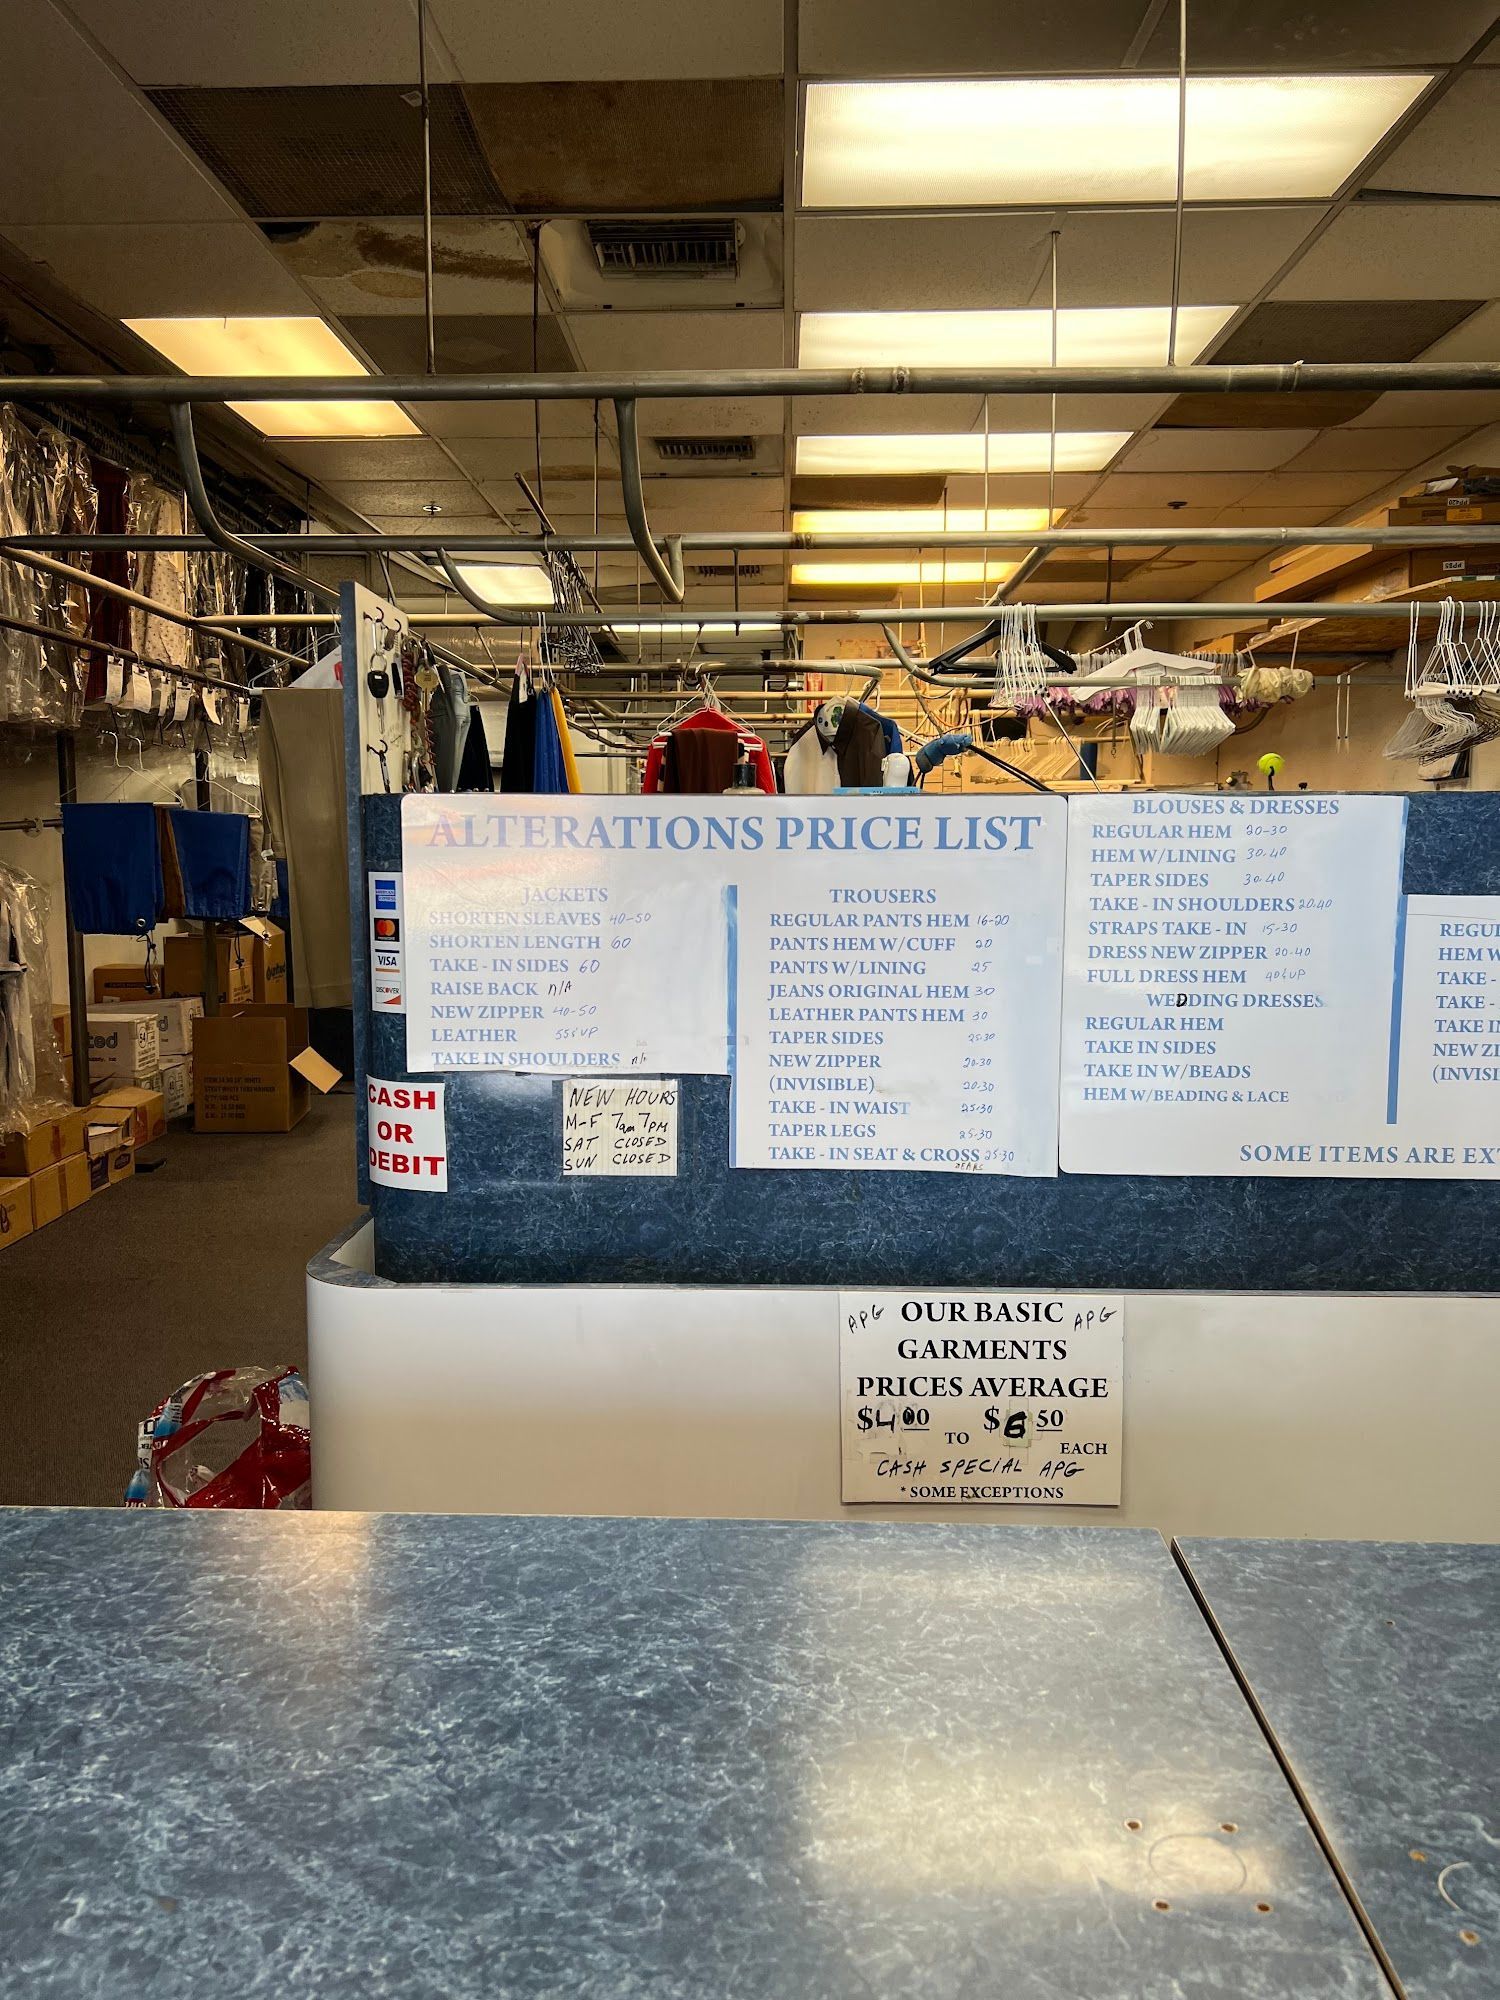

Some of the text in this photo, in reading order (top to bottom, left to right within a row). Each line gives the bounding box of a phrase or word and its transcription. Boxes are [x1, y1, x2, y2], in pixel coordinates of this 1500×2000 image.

[1132, 800, 1339, 814] BLOUSES & DRESSES
[426, 814, 1041, 851] ALTERATIONS PRICE LIST
[1093, 825, 1288, 838] REGULAR HEM 20-30
[1092, 849, 1135, 862] HEM
[1139, 848, 1236, 864] W/LINING
[1090, 873, 1152, 886] TAPER
[1155, 873, 1208, 887] SIDES
[521, 887, 608, 905] JACKETS
[829, 889, 936, 903] TROUSERS
[1090, 898, 1138, 910] TAKE
[1153, 898, 1174, 911] IN
[1178, 898, 1294, 911] SHOULDERS
[430, 912, 518, 926] SHORTEN
[523, 912, 601, 926] SLEAVES
[770, 914, 859, 927] REGULAR
[863, 914, 922, 927] PANTS
[927, 914, 969, 927] HEM
[1089, 922, 1157, 935] STRAPS
[1162, 922, 1211, 935] TAKE
[1226, 922, 1246, 935] IN
[430, 935, 631, 949] SHORTEN LENGTH 60
[770, 937, 828, 950] PANTS
[833, 938, 875, 950] HEM
[879, 937, 955, 952] W/CUFF
[1088, 946, 1147, 959] DRESS
[1151, 946, 1196, 959] NEW
[1200, 946, 1268, 959] ZIPPER
[1439, 948, 1483, 961] HEM
[378, 956, 397, 966] VISA
[430, 959, 600, 973] TAKE IN SIDES 60
[770, 961, 828, 974] PANTS
[832, 960, 925, 976] W/LINING
[1088, 970, 1135, 982] FULL
[1139, 970, 1198, 983] DRESS
[1203, 970, 1246, 983] HEM
[1437, 972, 1486, 985] TAKE
[376, 986, 400, 994] DISCOVER
[431, 982, 483, 995] RAISE
[488, 982, 539, 995] BACK
[767, 985, 995, 1001] JEANS ORIGINAL HEM 30
[1146, 993, 1325, 1009] WEDDING DRESSES
[1436, 996, 1485, 1009] TAKE
[431, 1006, 474, 1018] NEW
[478, 1006, 544, 1019] ZIPPER
[769, 1008, 988, 1022] LEATHER PANTS HEM 30
[1086, 1017, 1224, 1030] REGULAR HEM
[1435, 1020, 1483, 1033] TAKE
[432, 1029, 517, 1042] LEATHER
[769, 1031, 828, 1044] TAPER
[832, 1031, 883, 1044] SIDES
[1085, 1041, 1216, 1054] TAKE IN SIDES
[1433, 1044, 1478, 1056] NEW
[432, 1052, 647, 1068] TAKE IN SHOULDERS n/
[769, 1055, 812, 1067] NEW
[816, 1055, 881, 1068] ZIPPER
[1084, 1064, 1250, 1079] TAKE IN W/BEADS
[770, 1075, 875, 1094] (INVISIBLE)
[368, 1084, 436, 1110] CASH
[570, 1085, 678, 1108] NEW HOURS
[1084, 1088, 1289, 1102] HEM W/BEADING & LACE
[769, 1101, 816, 1113] TAKE
[830, 1101, 850, 1114] IN
[853, 1100, 911, 1115] WAIST
[566, 1112, 602, 1130] M-F
[378, 1121, 414, 1144] OR
[769, 1124, 827, 1136] TAPER
[832, 1125, 875, 1137] LEGS
[564, 1136, 667, 1152] SAT CLOSED
[370, 1146, 444, 1176] DEBIT
[564, 1153, 671, 1170] SUN CLOSED
[768, 1147, 815, 1159] TAKE
[830, 1148, 849, 1160] IN
[854, 1148, 898, 1160] SEAT
[903, 1148, 915, 1161] &
[921, 1148, 979, 1162] CROSS
[1240, 1145, 1500, 1164] SOME ITEMS ARE EX
[902, 1302, 1063, 1322] OUR BASIC
[898, 1339, 1066, 1360] GARMENTS
[857, 1377, 1108, 1398] PRICES AVERAGE
[945, 1432, 969, 1444] TO
[1060, 1443, 1108, 1454] EACH
[877, 1460, 927, 1477] CASH
[940, 1458, 1023, 1474] SPECIAL
[910, 1486, 956, 1498] SOME
[960, 1487, 1063, 1500] EXCEPTIONS
